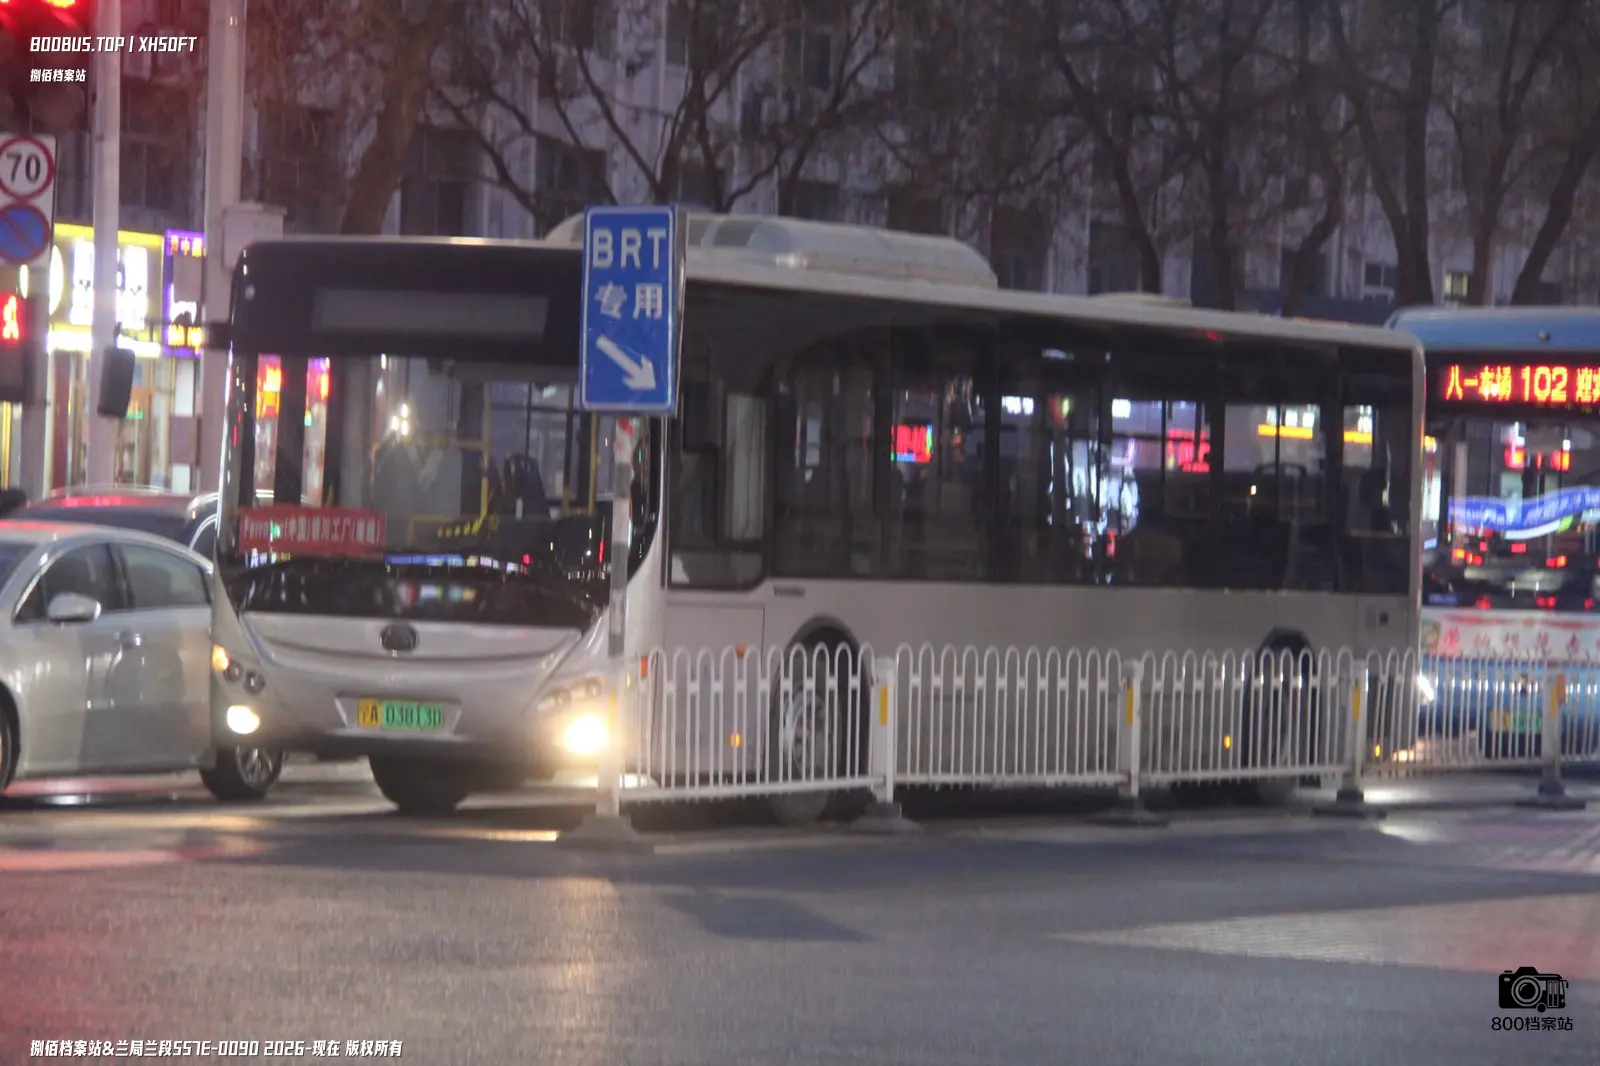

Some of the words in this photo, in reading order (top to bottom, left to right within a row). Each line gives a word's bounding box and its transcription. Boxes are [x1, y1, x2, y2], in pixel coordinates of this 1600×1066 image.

[6, 152, 41, 184] 70
[593, 228, 666, 269] BRT
[595, 281, 663, 319] 专用
[1521, 366, 1568, 402] 102
